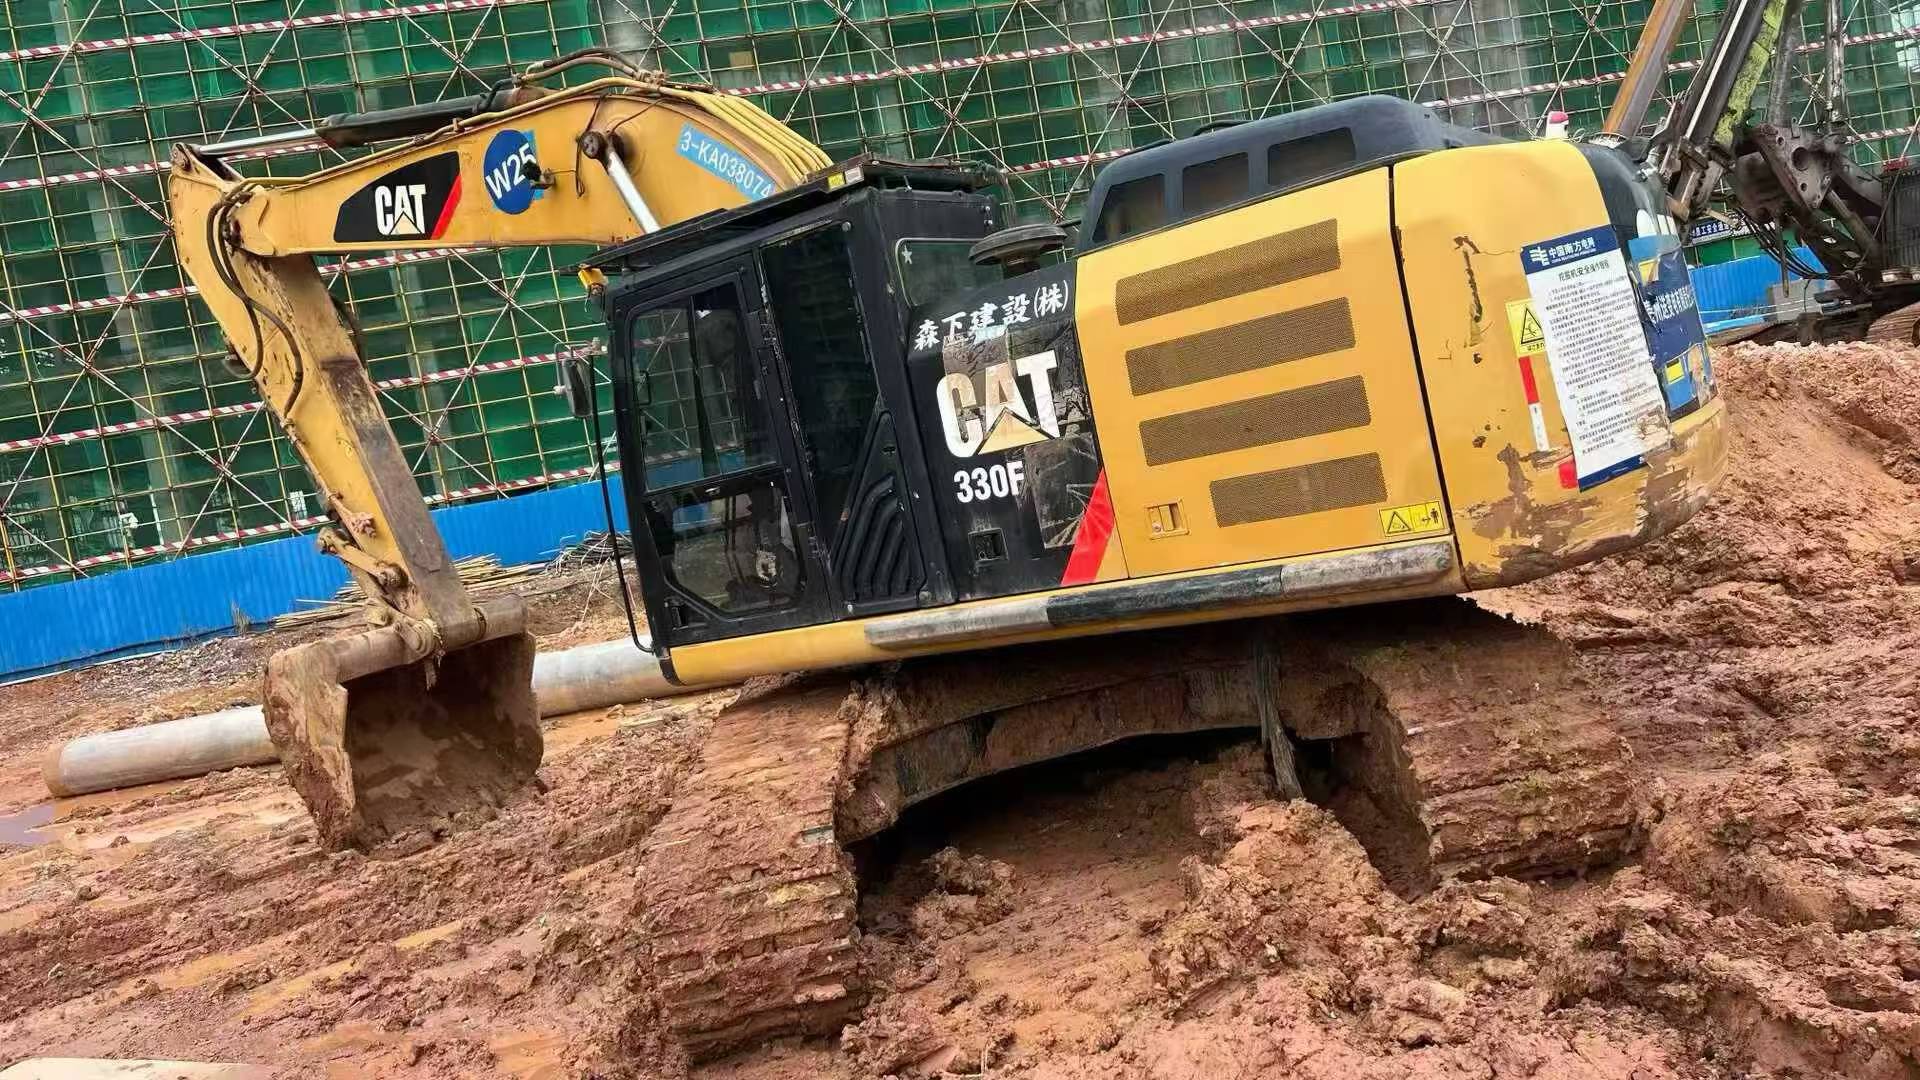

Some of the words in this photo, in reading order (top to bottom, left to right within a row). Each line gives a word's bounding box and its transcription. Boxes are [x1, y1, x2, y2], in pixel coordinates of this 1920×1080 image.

[681, 131, 772, 198] 3-KA038074
[374, 184, 427, 235] CAT
[1548, 236, 1596, 258] 中国南方电网
[914, 279, 1069, 350] 森下建設(株)
[936, 350, 1060, 458] CAT
[953, 460, 1025, 503] 330F
